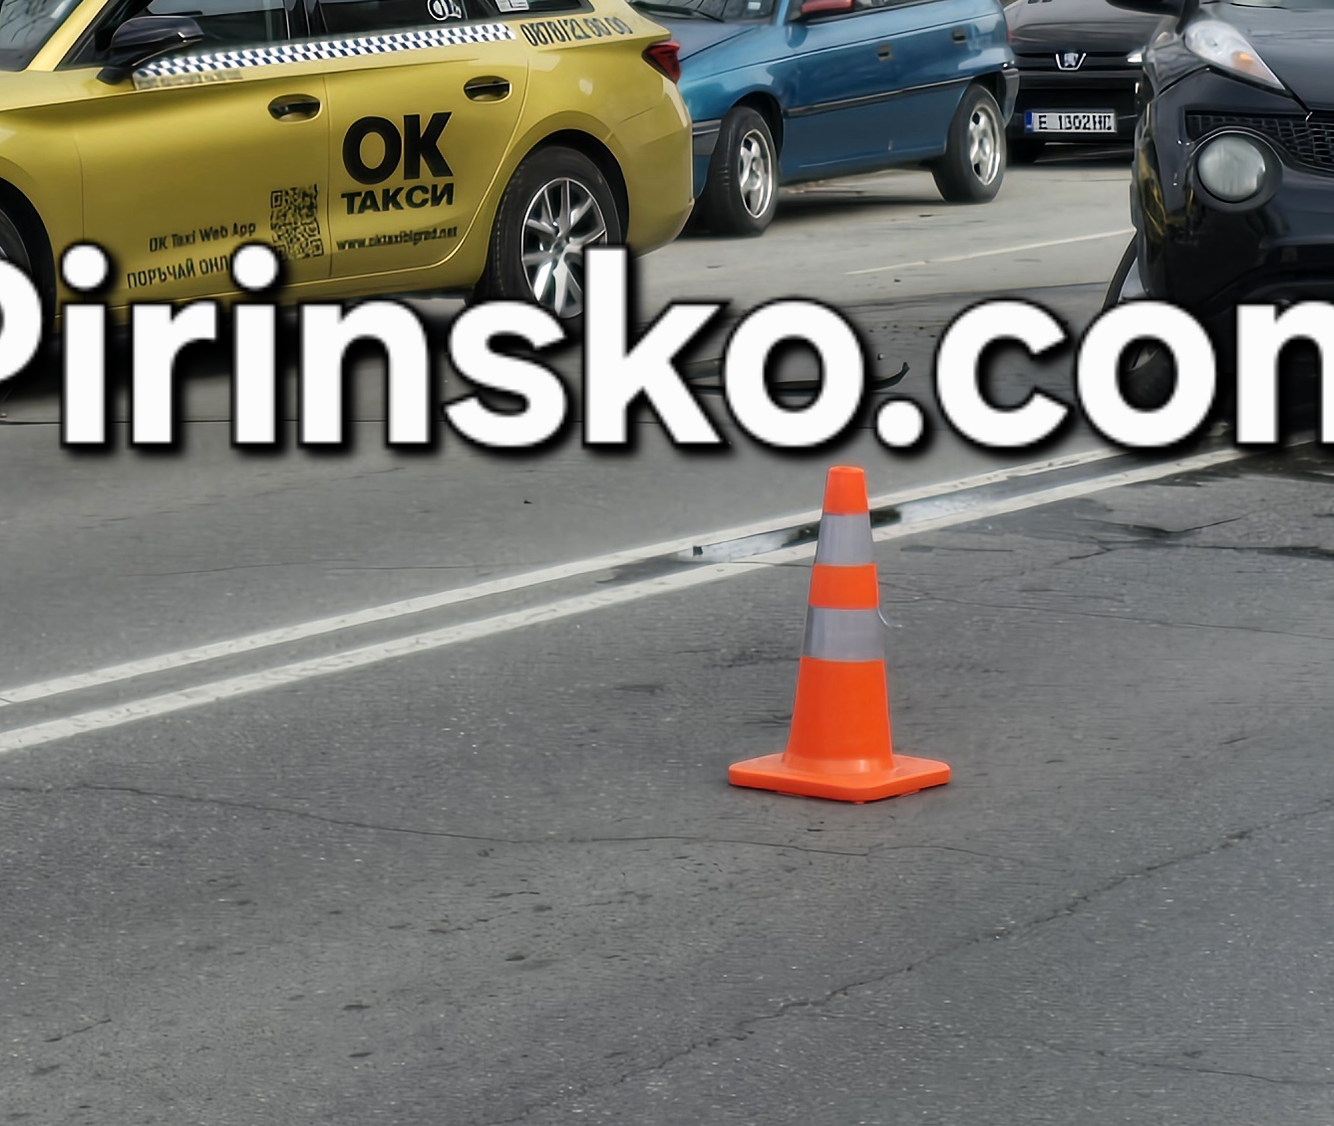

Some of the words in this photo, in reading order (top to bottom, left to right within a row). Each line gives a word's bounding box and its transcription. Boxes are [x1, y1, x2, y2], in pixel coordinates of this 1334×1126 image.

[1038, 115, 1048, 130] E
[342, 111, 454, 185] OK
[341, 183, 454, 215] ТАКСИ
[127, 257, 196, 289] ПОРЪЧАЙ
